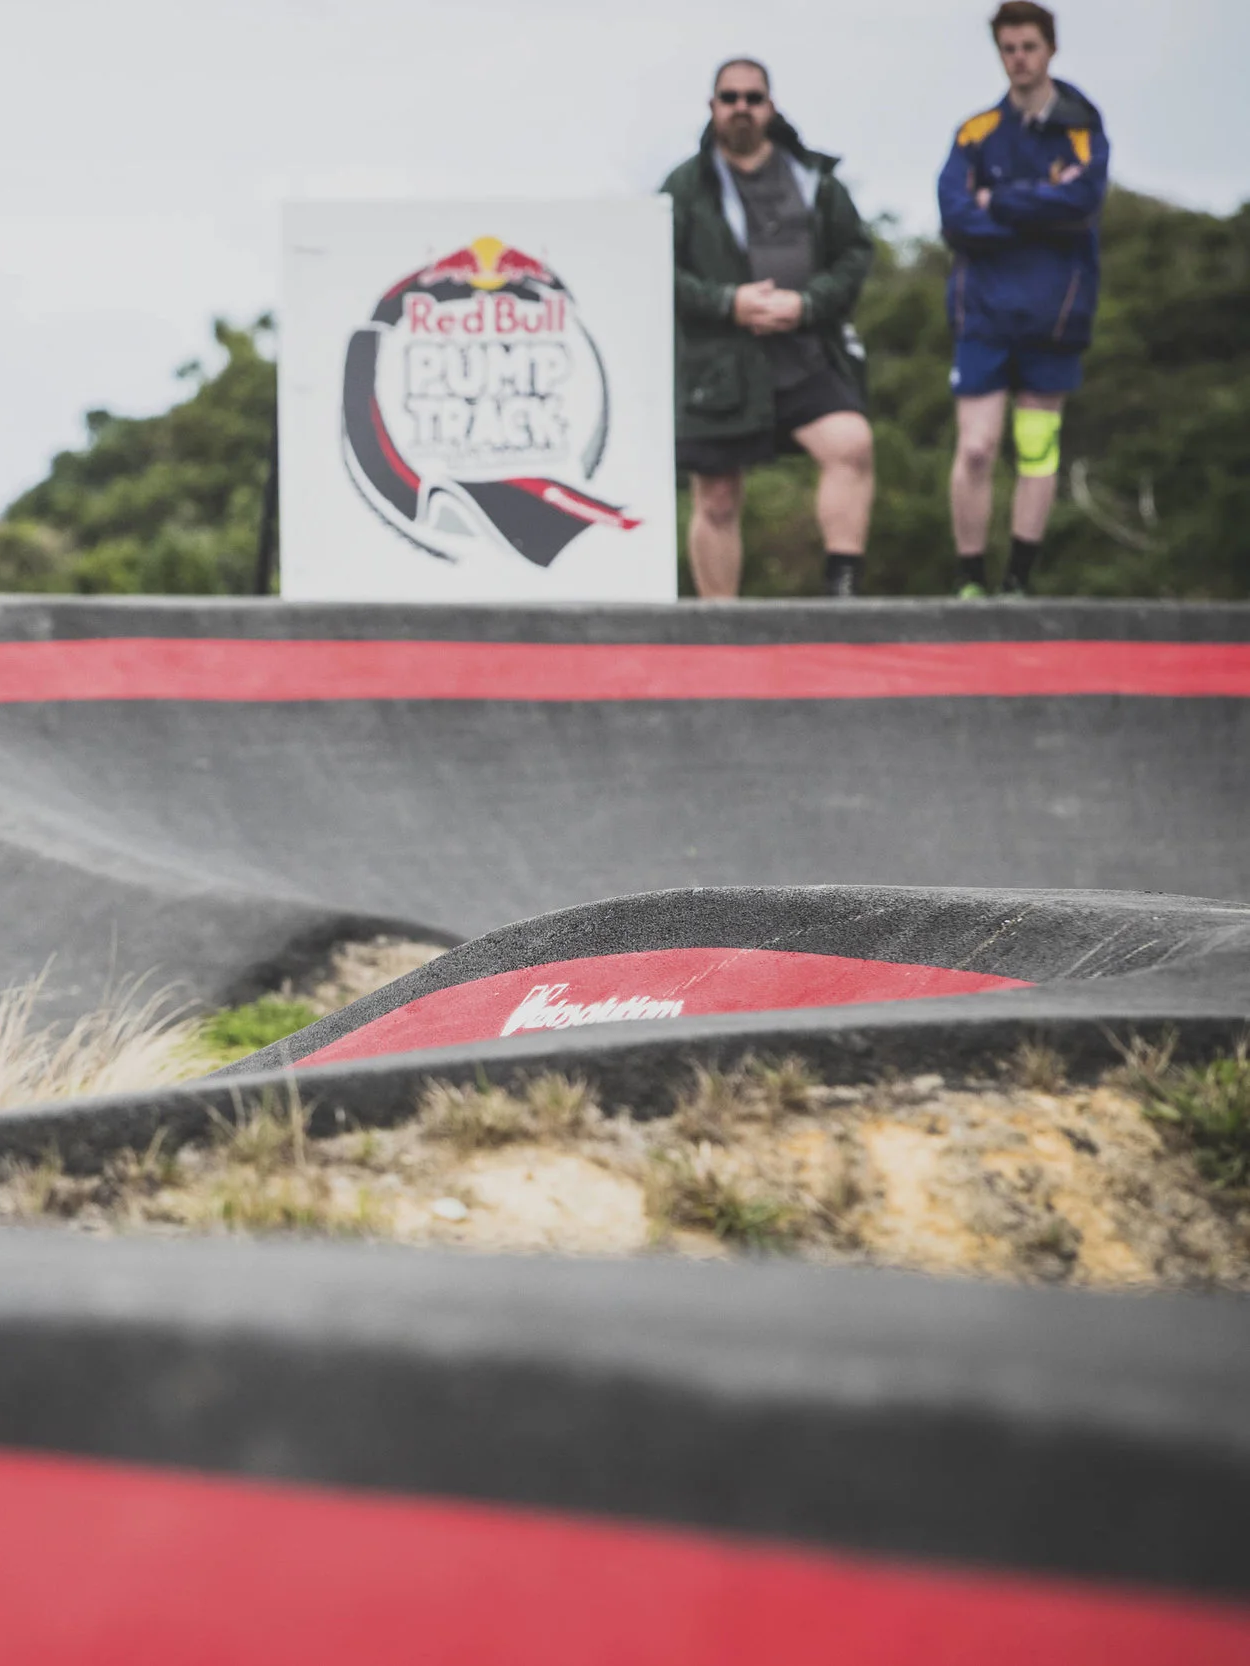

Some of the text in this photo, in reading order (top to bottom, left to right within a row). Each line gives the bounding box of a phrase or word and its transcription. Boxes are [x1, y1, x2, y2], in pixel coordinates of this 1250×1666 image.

[410, 299, 565, 334] Red Bull
[406, 343, 567, 397] PUMP
[406, 398, 567, 447] TRACK
